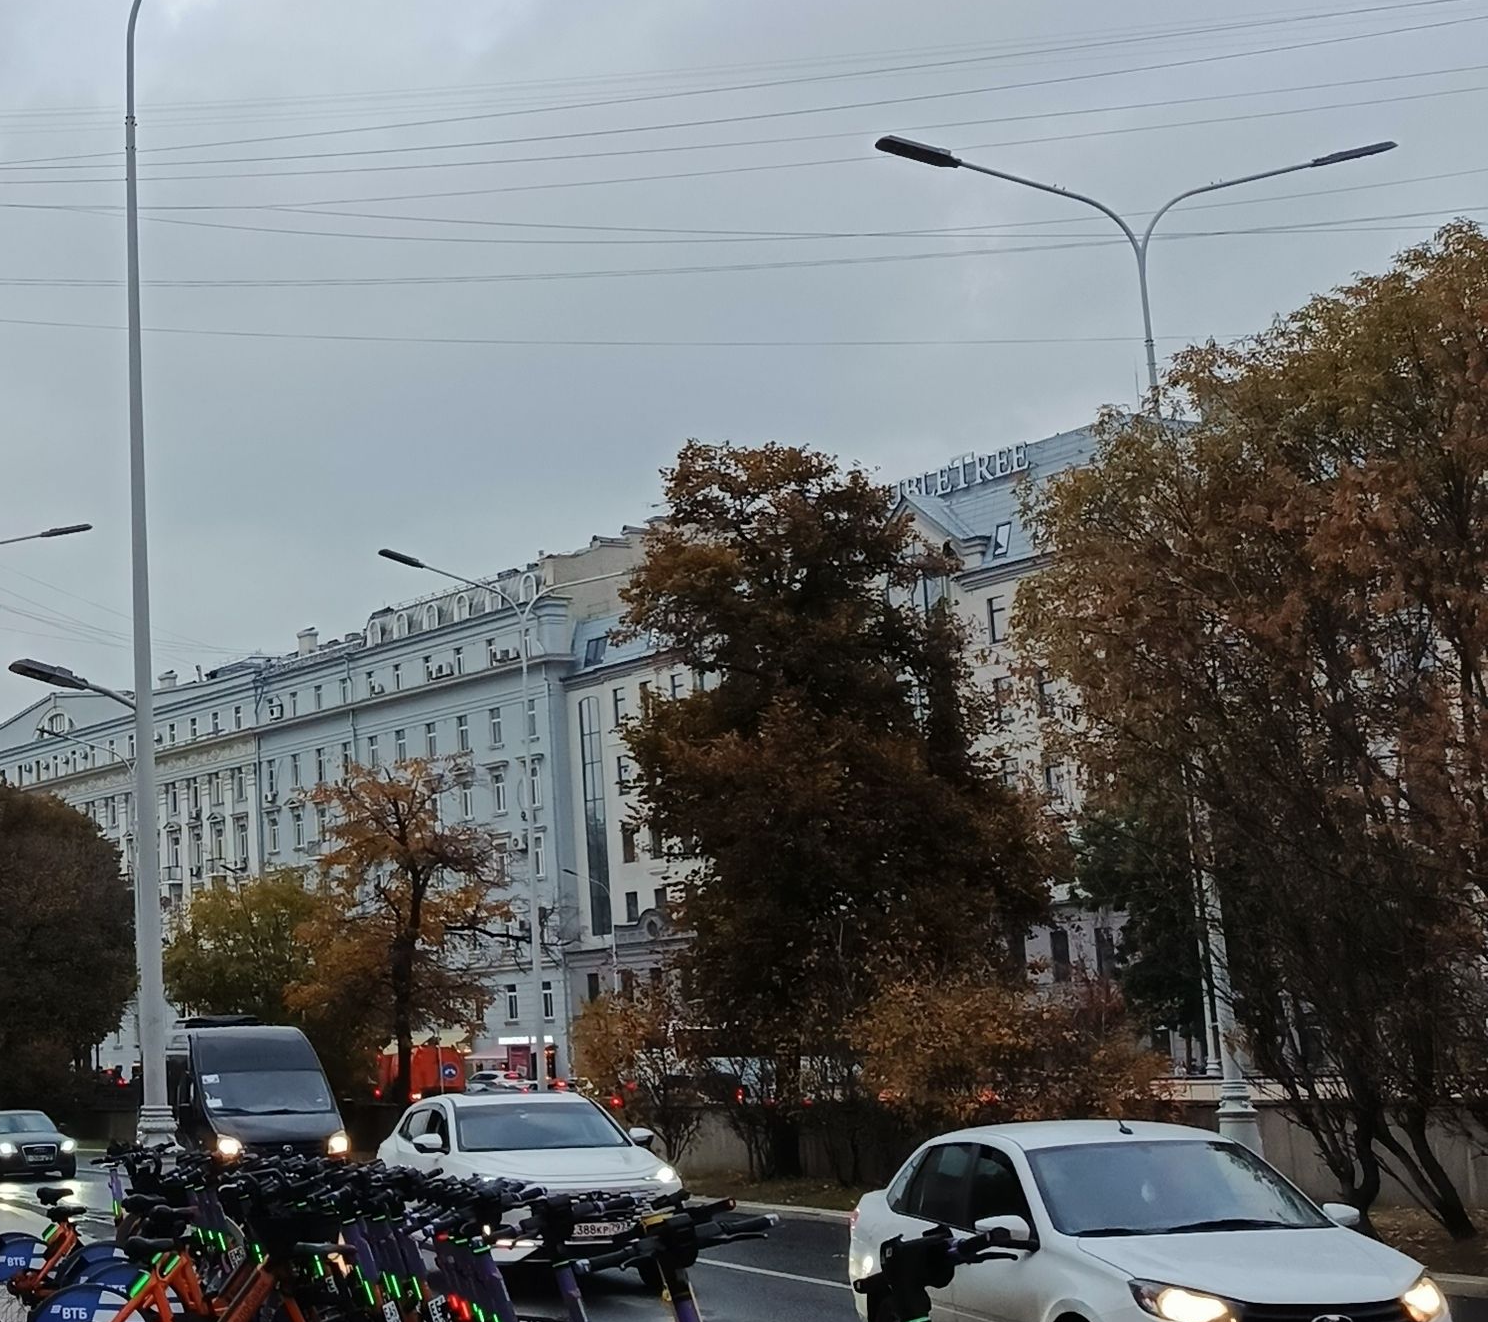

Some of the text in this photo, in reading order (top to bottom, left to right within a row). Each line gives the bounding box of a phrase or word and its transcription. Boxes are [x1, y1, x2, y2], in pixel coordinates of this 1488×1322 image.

[888, 443, 1031, 510] UBLETREE
[572, 1224, 610, 1236] 388КР
[7, 1256, 26, 1267] ВТБ
[62, 1307, 88, 1320] ВТБ
